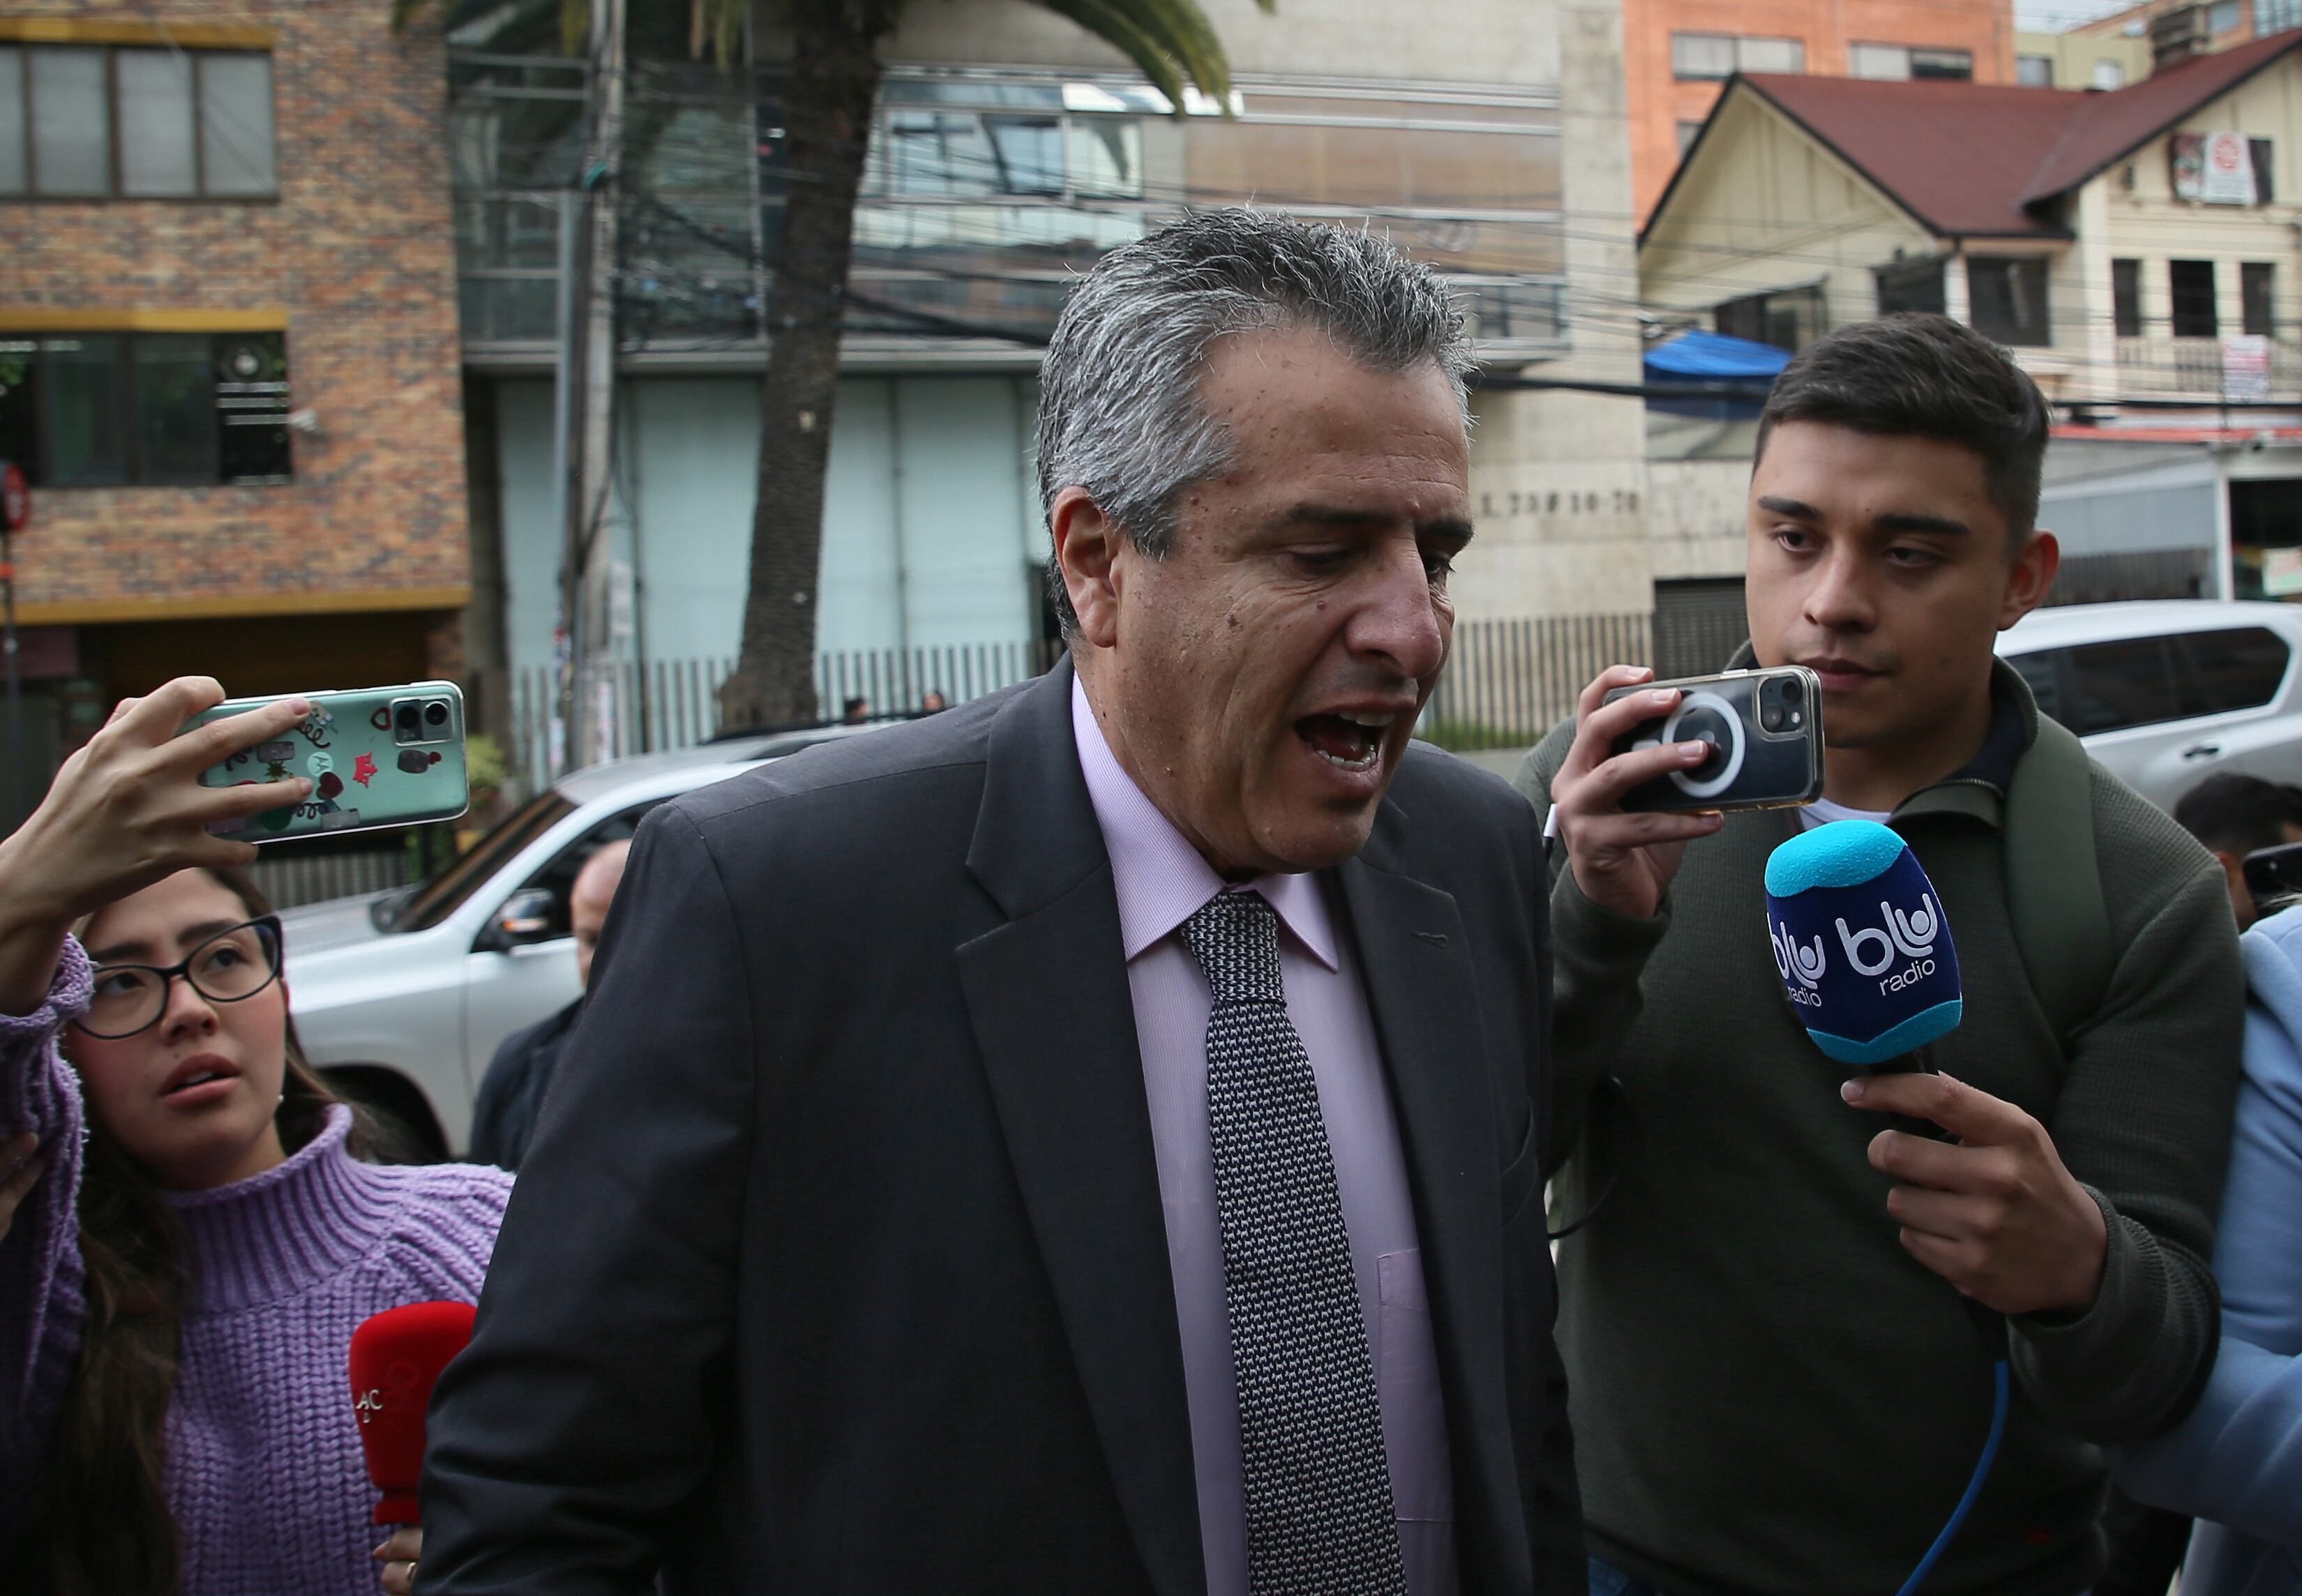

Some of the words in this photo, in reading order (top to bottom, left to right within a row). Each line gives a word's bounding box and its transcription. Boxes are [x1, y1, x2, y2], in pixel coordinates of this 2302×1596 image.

[1766, 912, 1826, 990] blu
[1835, 893, 1939, 977] blu
[1787, 985, 1822, 1007] radio
[1879, 958, 1936, 996] radio
